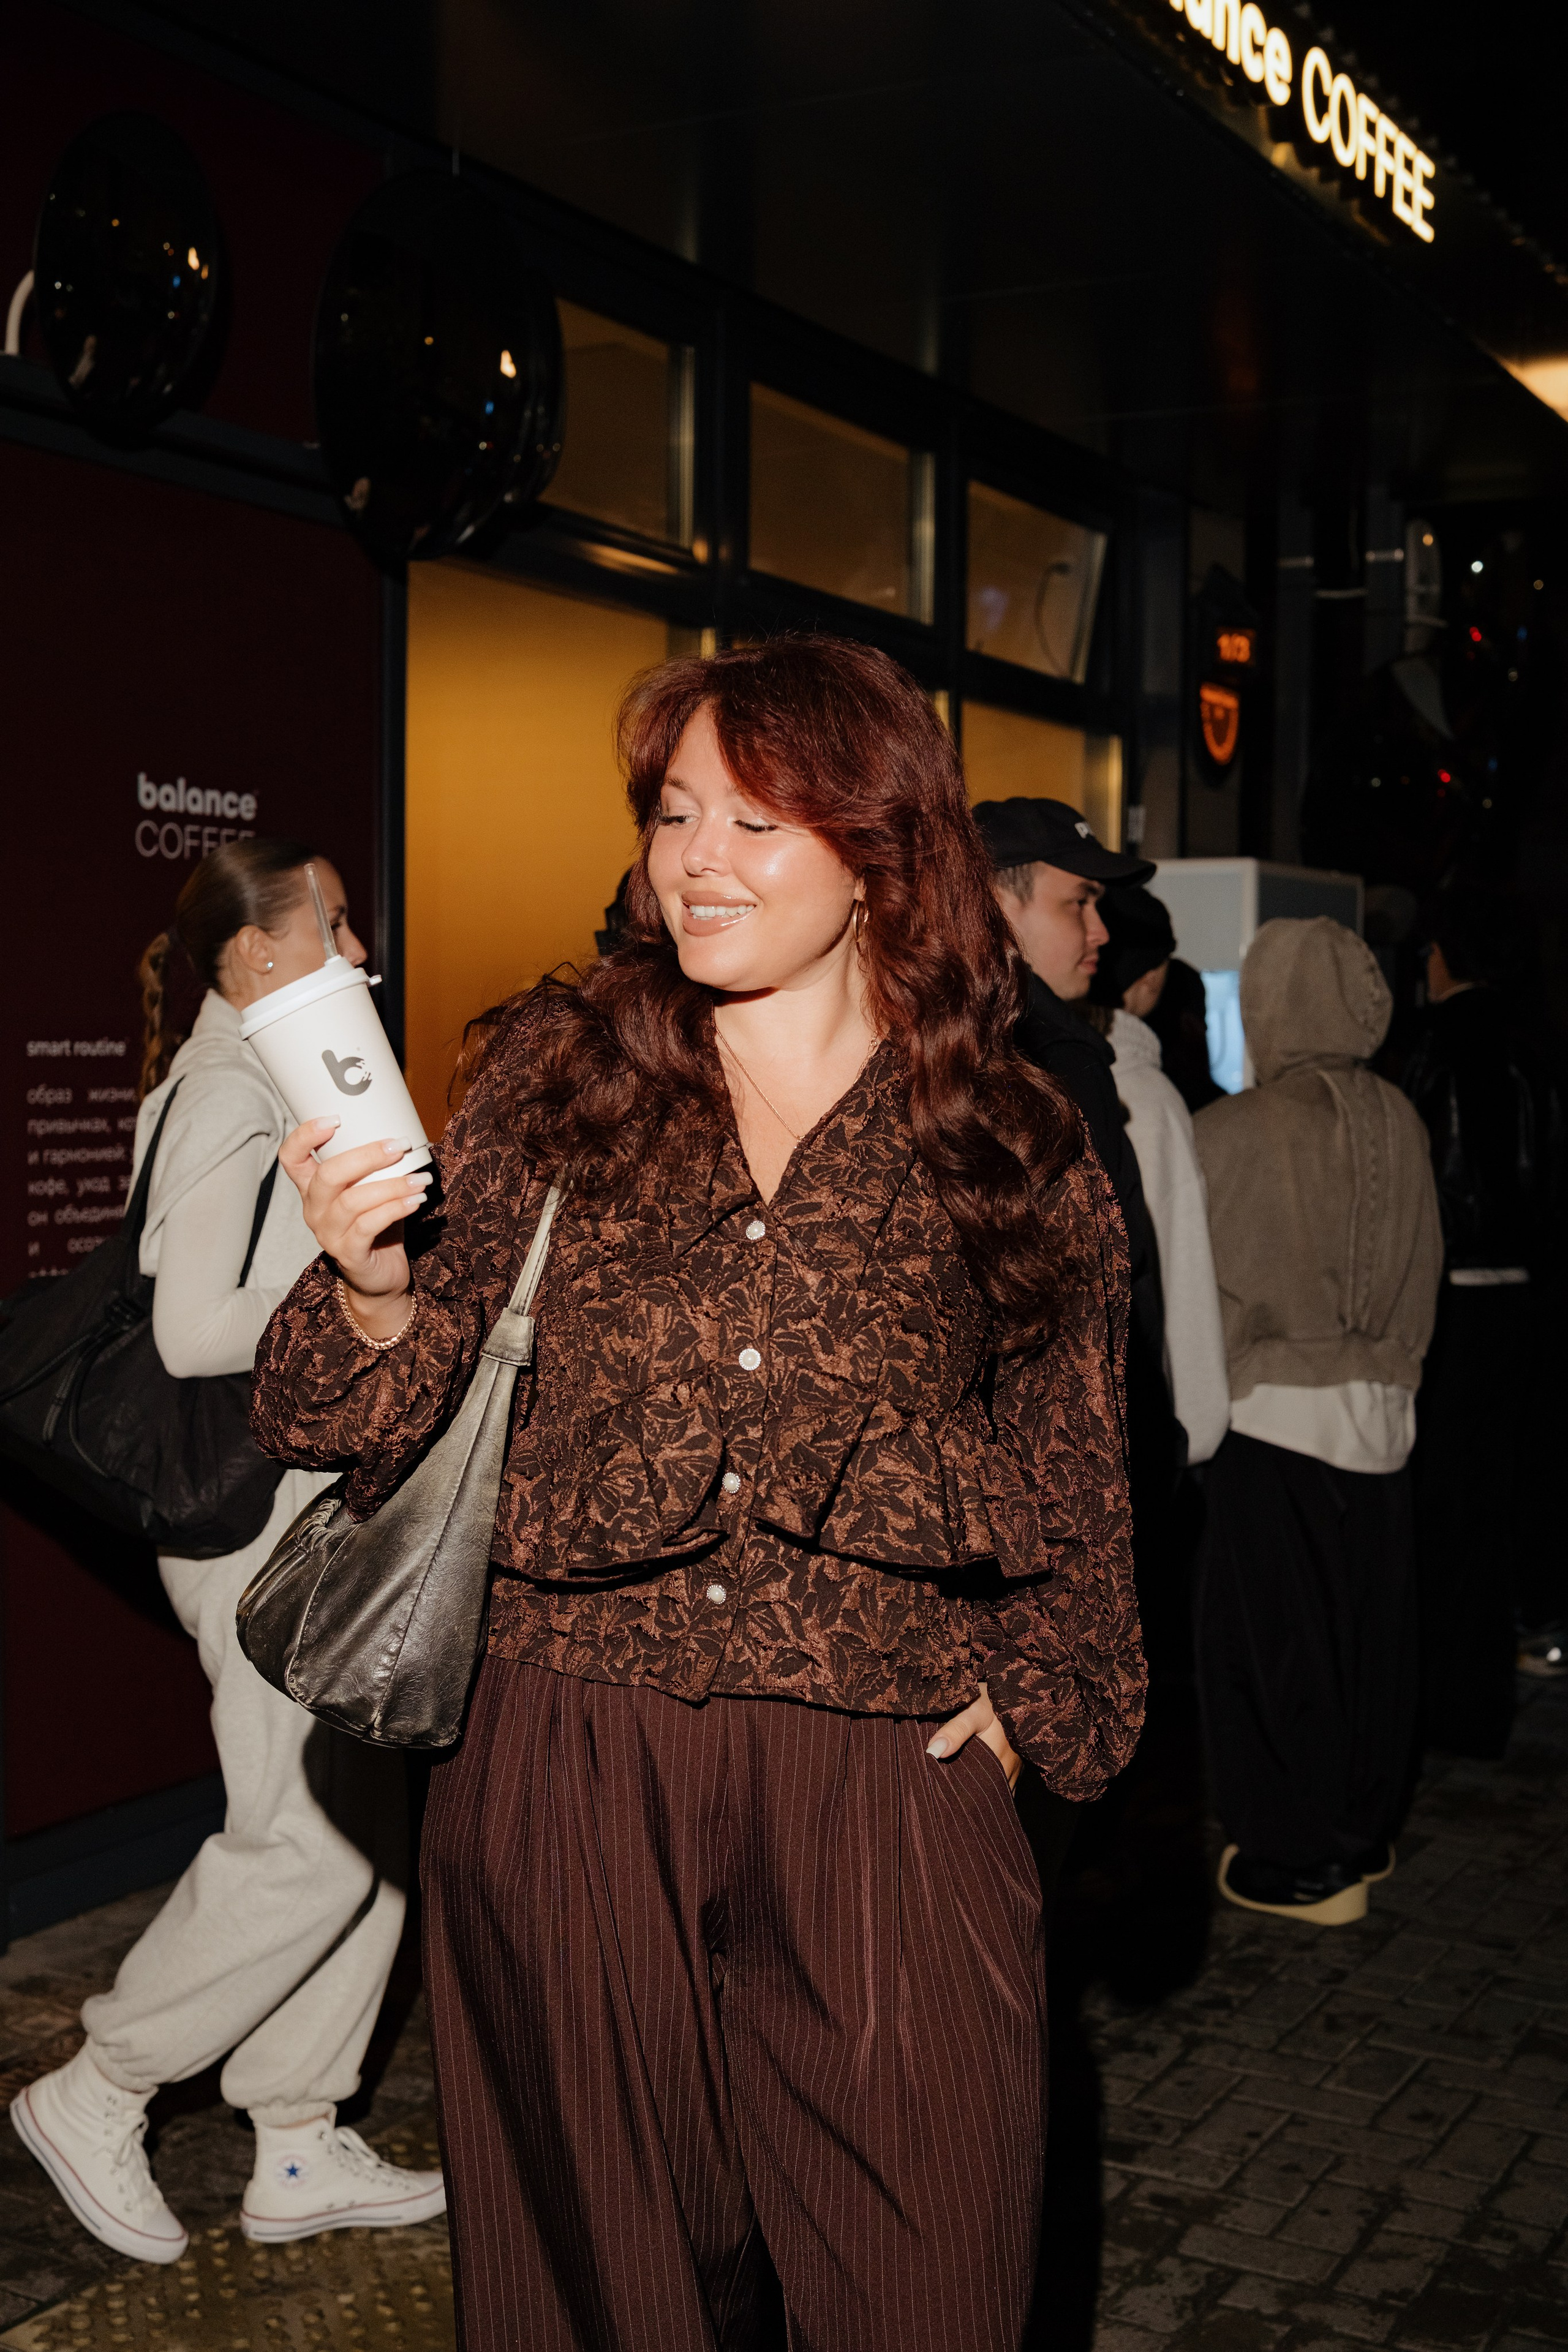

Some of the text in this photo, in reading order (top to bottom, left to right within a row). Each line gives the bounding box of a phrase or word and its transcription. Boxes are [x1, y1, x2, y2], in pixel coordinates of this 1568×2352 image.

[1167, 0, 1436, 243] nce COFFEE
[137, 771, 258, 821] balance
[26, 1037, 126, 1057] smart routine
[26, 1084, 73, 1107] образ
[27, 1150, 40, 1166] и
[28, 1176, 70, 1199] кофе,
[76, 1176, 111, 1197] уход
[27, 1210, 49, 1227] он
[27, 1241, 40, 1257] и
